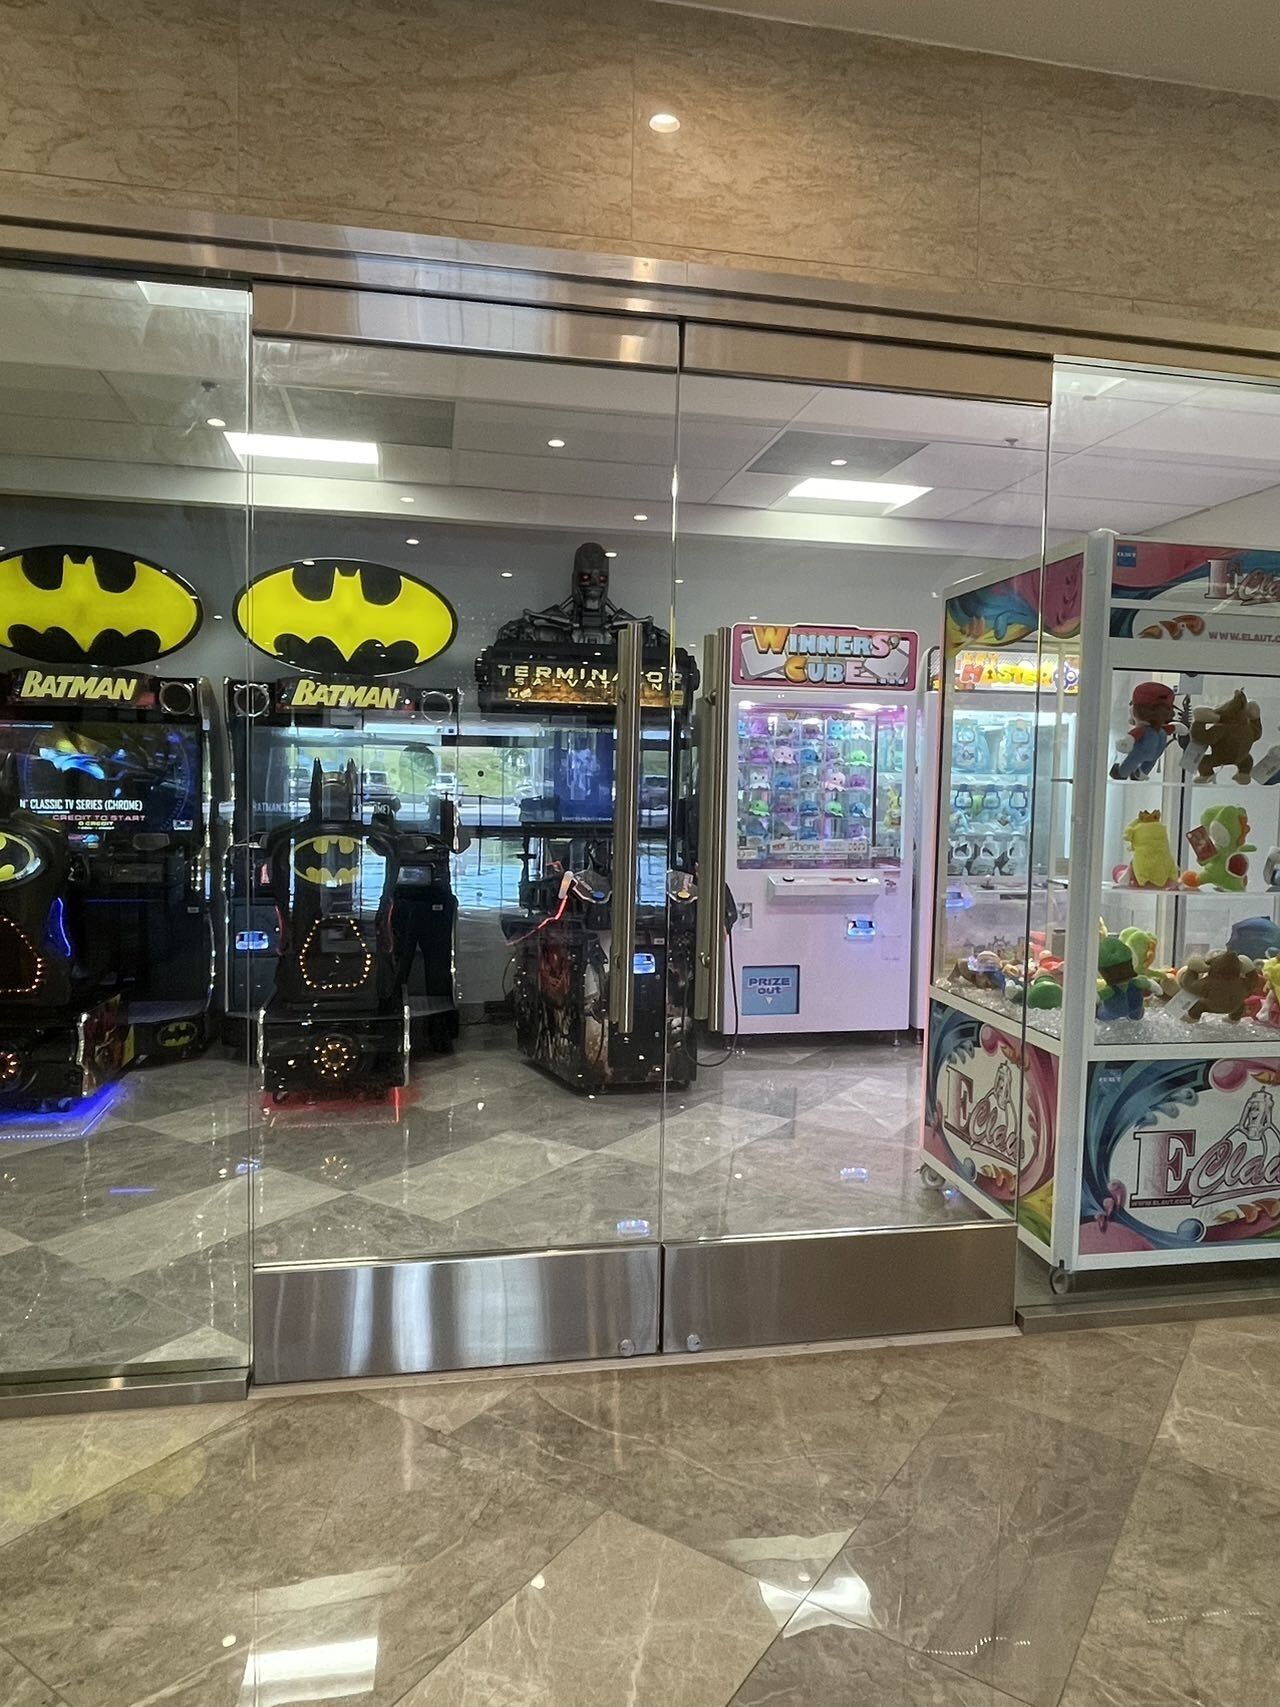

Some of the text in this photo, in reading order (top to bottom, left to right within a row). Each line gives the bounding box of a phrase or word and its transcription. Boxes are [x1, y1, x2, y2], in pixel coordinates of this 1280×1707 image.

[497, 664, 683, 683] TERMINOR
[784, 656, 877, 684] CUBE
[20, 670, 138, 701] BATMAN
[514, 677, 663, 691] SALVATN
[291, 679, 400, 709] BATMAN
[30, 799, 63, 810] CLASSIC
[65, 800, 74, 810] TV
[76, 800, 103, 810] SERIES
[104, 800, 143, 811] (CHROME)
[749, 977, 791, 986] PRIZE
